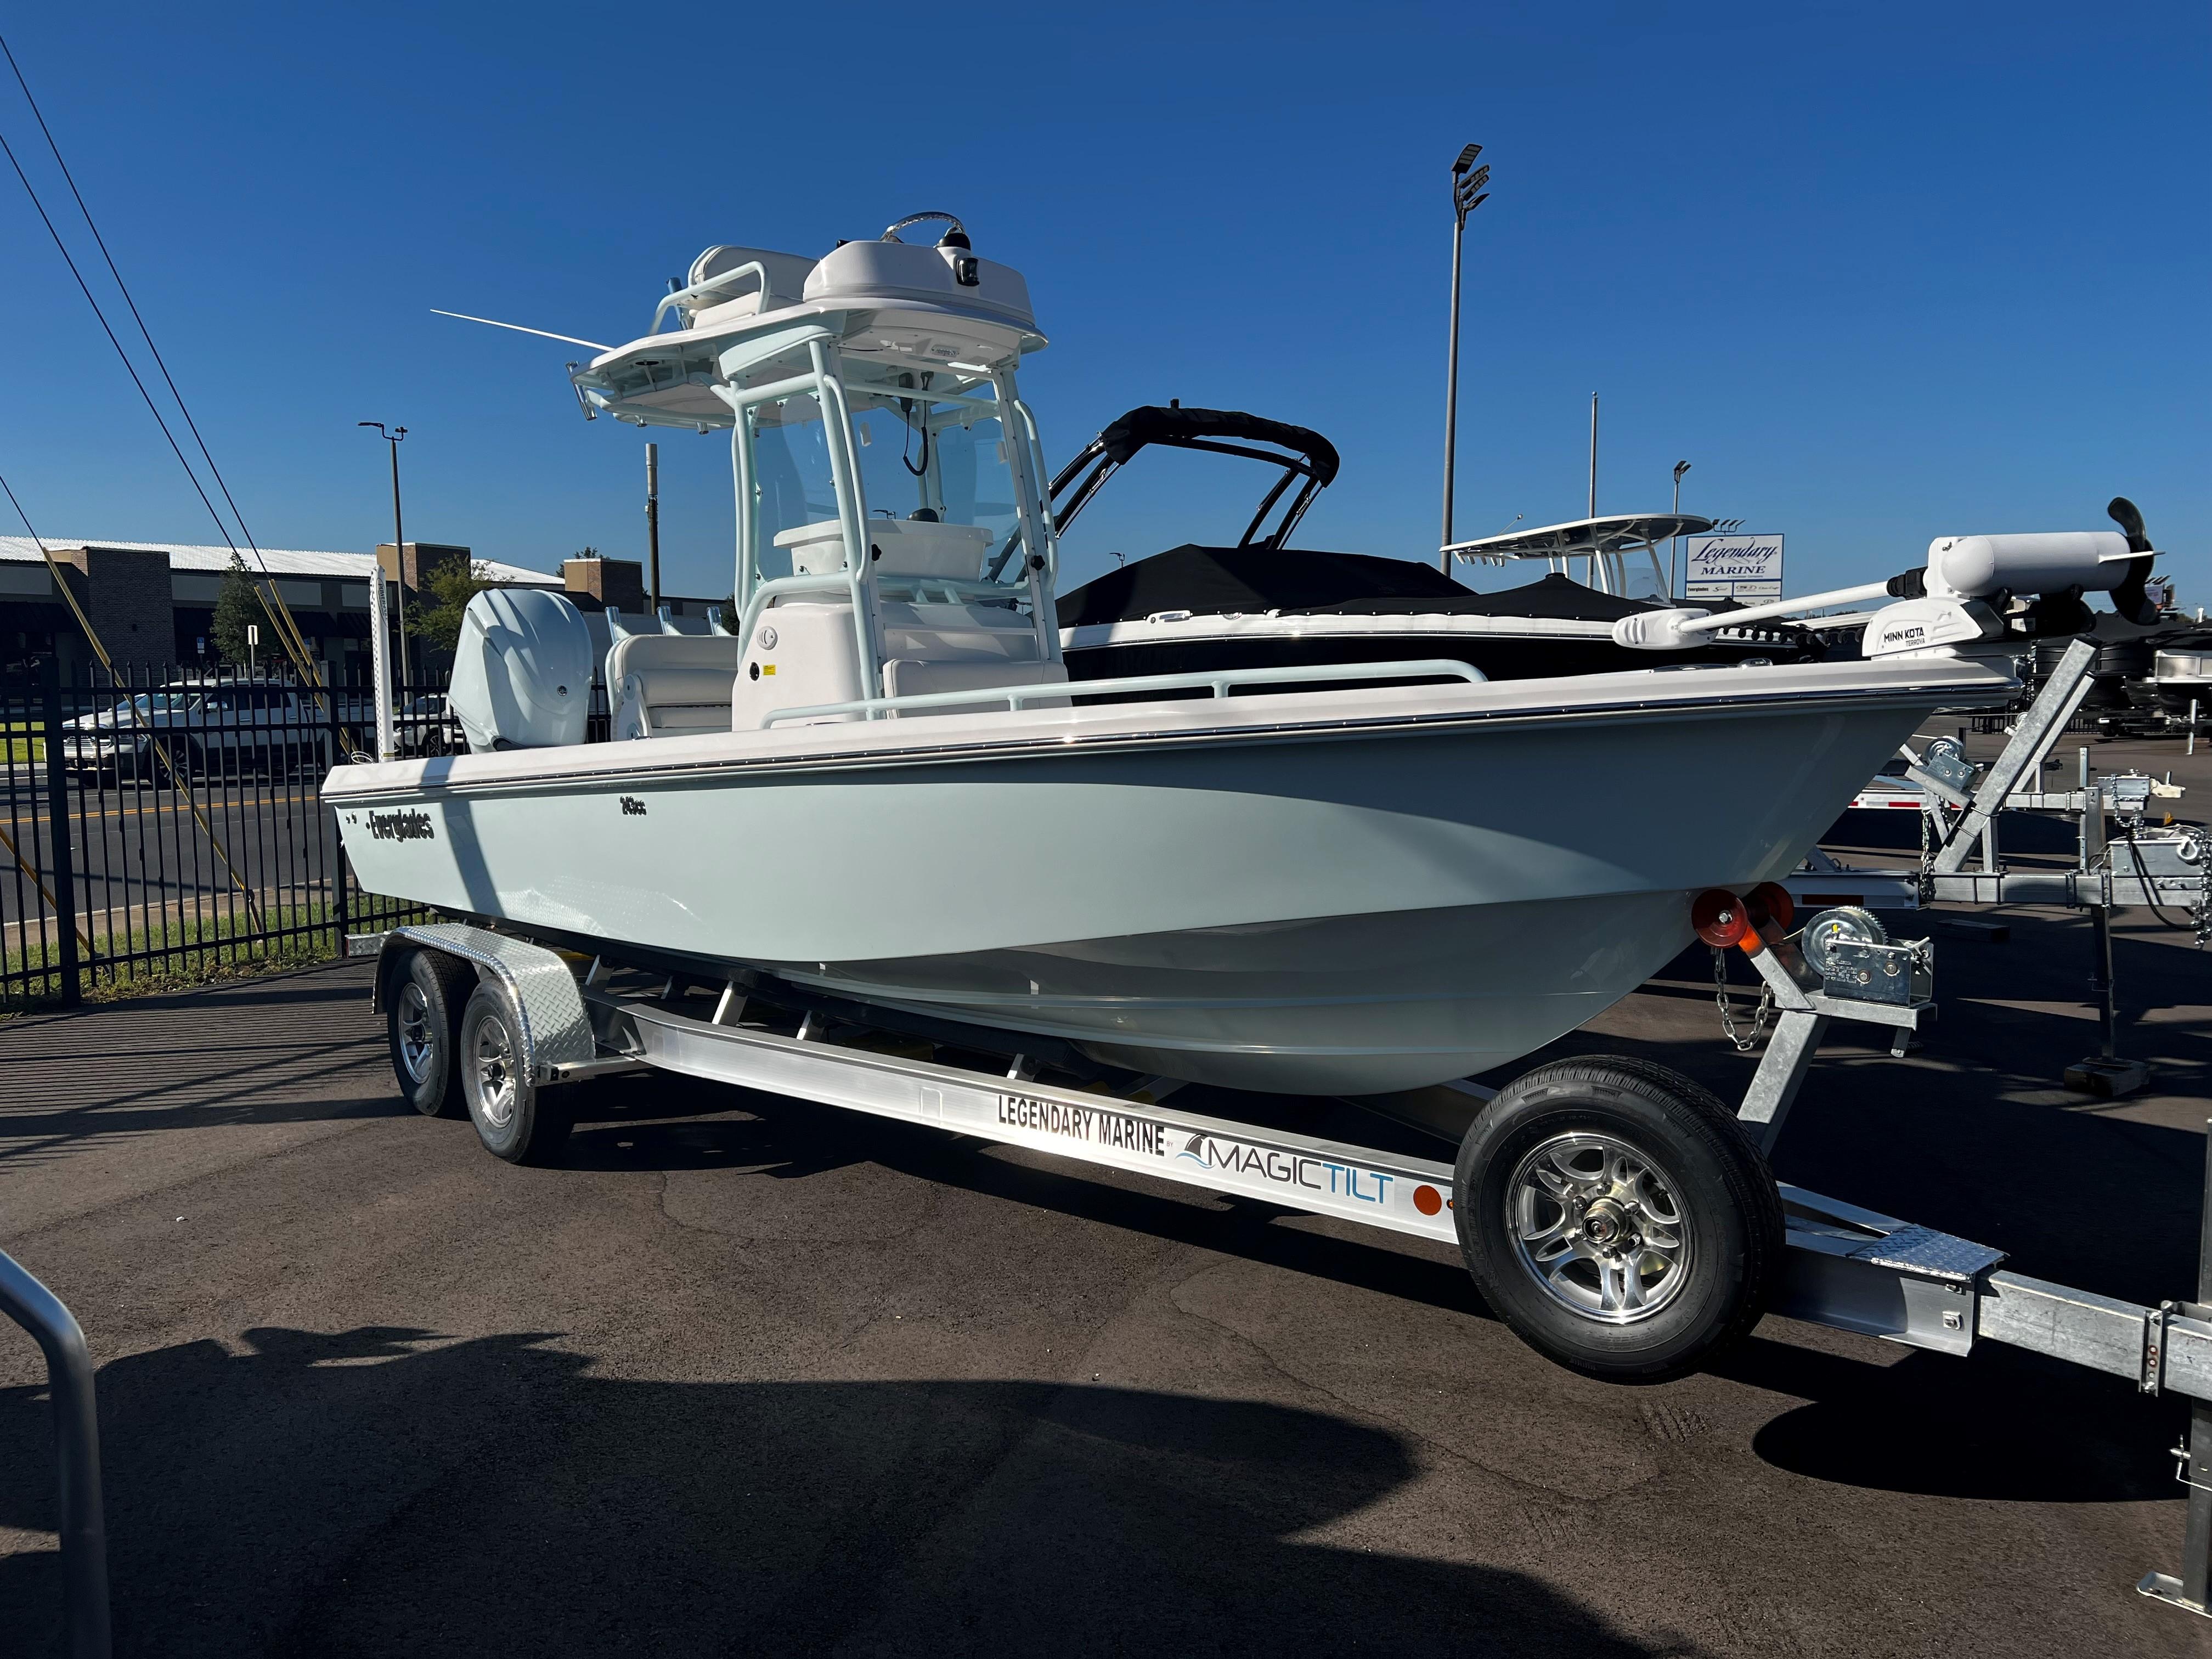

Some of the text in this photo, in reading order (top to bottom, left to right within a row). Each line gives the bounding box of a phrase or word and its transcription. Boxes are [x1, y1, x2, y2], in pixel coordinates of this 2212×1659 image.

[1691, 537, 1778, 564] Legendary
[1701, 566, 1766, 575] MARINE
[1884, 627, 1925, 642] MINN KOTA
[1906, 637, 1926, 647] TERROVA
[369, 808, 435, 843] Everglades
[998, 1095, 1093, 1141] LEGENDARY
[1098, 1113, 1164, 1157] MARINE
[1208, 1139, 1393, 1204] MAGICTILT
